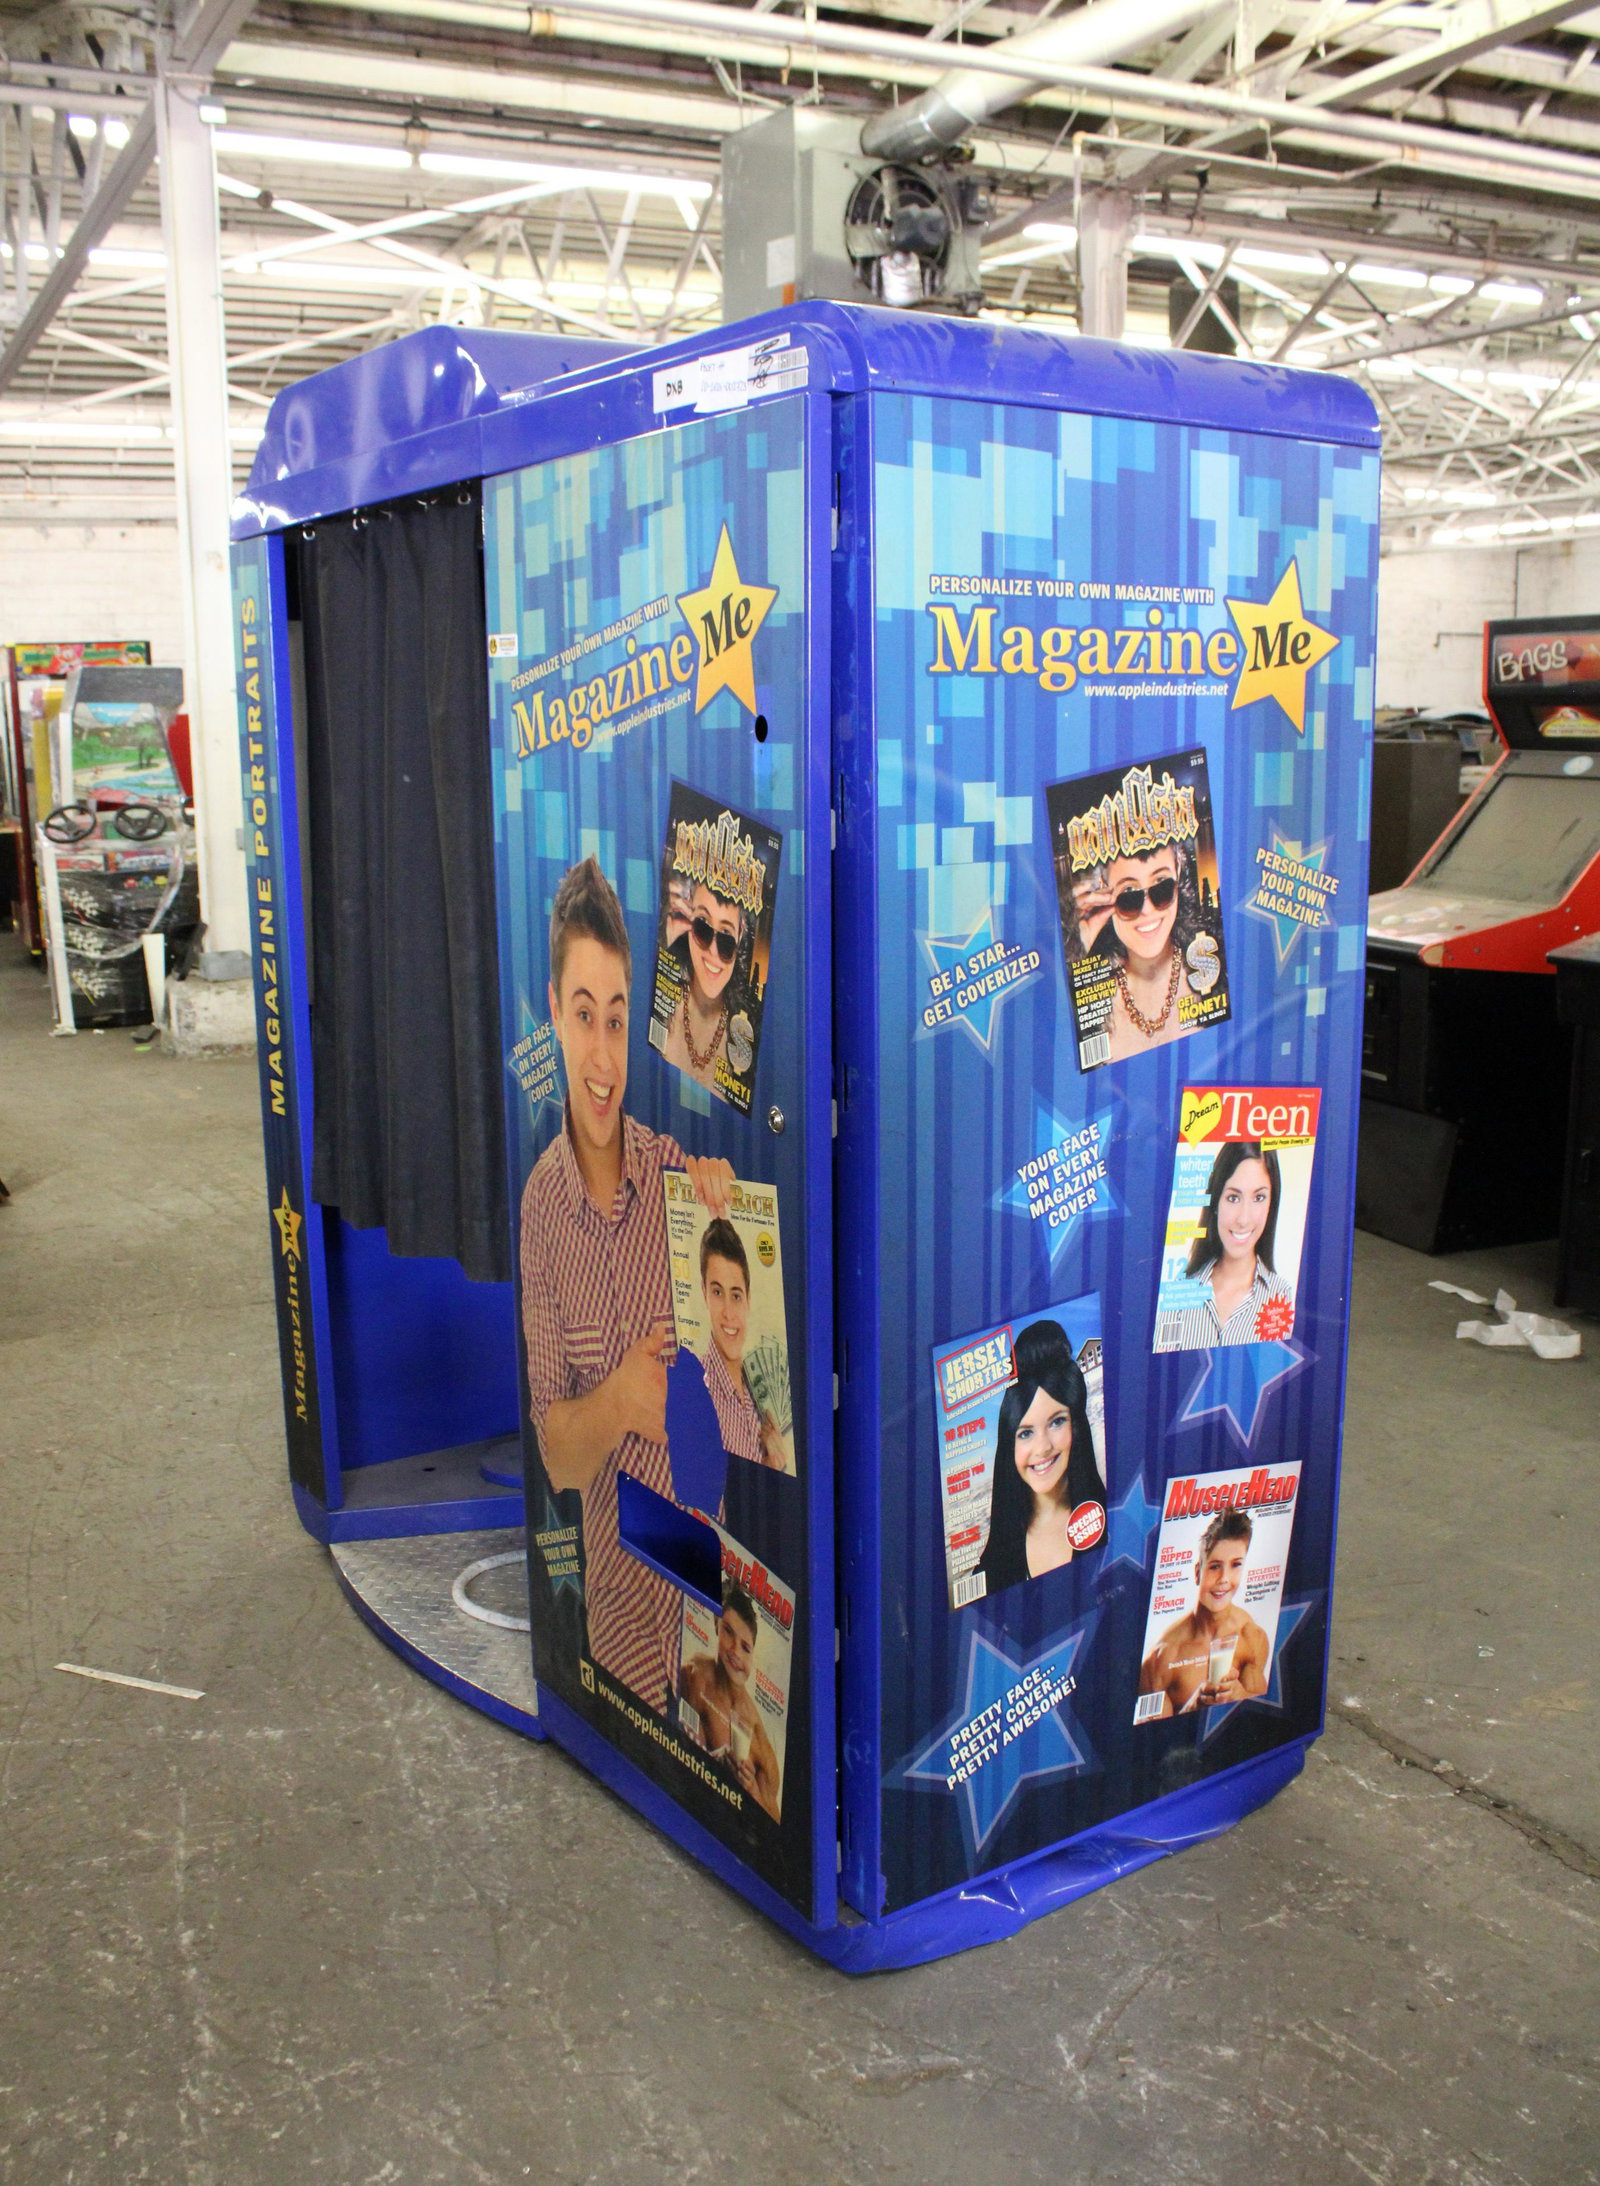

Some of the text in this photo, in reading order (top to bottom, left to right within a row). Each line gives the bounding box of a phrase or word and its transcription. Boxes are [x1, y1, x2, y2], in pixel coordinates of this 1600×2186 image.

[930, 575, 1214, 604] PERSONALIZE YOUR OWN MAGAZINE WITH
[511, 596, 669, 692] PERSONALIZE YOUR OWN MAGAZINE WITH
[928, 606, 1311, 692] Magazine Me
[1498, 640, 1569, 682] BAGS
[512, 592, 754, 758] Magazine Me
[1084, 682, 1229, 700] www.appleindustries.net
[241, 597, 286, 1116] MAGAZINE PORTRAITS
[1256, 848, 1340, 894] PERSONALIZE
[1260, 870, 1327, 910] YOUR OWN
[1256, 890, 1322, 928] MAGAZINE
[930, 942, 1021, 997] BE A STAR...
[923, 951, 1040, 1027] GET COVERIZED
[1075, 979, 1116, 999] EXCLUSIVE
[1076, 987, 1117, 1007] INTERVIEW
[1178, 994, 1193, 1009] GET
[1077, 1005, 1089, 1015] HIP
[1079, 1006, 1112, 1023] GREATEST
[1179, 993, 1227, 1024] MONEY!
[513, 1022, 552, 1059] YOUR FACE
[519, 1040, 552, 1074] ON EVERY
[521, 1056, 558, 1091] MAGAZINE
[716, 1056, 728, 1072] GET
[531, 1078, 555, 1103] COVER
[715, 1067, 751, 1103] MONEY!
[1184, 1092, 1311, 1137] Dream Teen
[1017, 1123, 1101, 1184] YOUR FACE
[1027, 1143, 1099, 1199] ON EVERY
[1180, 1157, 1212, 1172] whiter
[1028, 1160, 1107, 1220] MAGAZINE
[1178, 1174, 1205, 1188] teeth
[1048, 1187, 1098, 1228] COVER
[678, 1314, 694, 1326] Europe
[287, 1253, 308, 1425] Magazine
[945, 1333, 1007, 1385] JERSEY
[946, 1357, 1013, 1404] SHORTIES
[957, 1416, 986, 1438] STEPS
[536, 1527, 578, 1547] PERSONALIZE
[1067, 1506, 1102, 1537] SPECIAL
[1073, 1519, 1102, 1546] ISSUE!
[543, 1544, 577, 1561] YOUR OWN
[547, 1560, 581, 1577] MAGAZINE
[1160, 1550, 1193, 1563] RIPPED
[1153, 1598, 1185, 1610] SPINACH
[949, 1675, 1066, 1770] PRETTY COVER...
[950, 1665, 1055, 1750] PRETTY FACE...
[598, 1681, 743, 1811] www.appleindustries.net
[946, 1676, 1077, 1791] PRETTY AWESOME!
